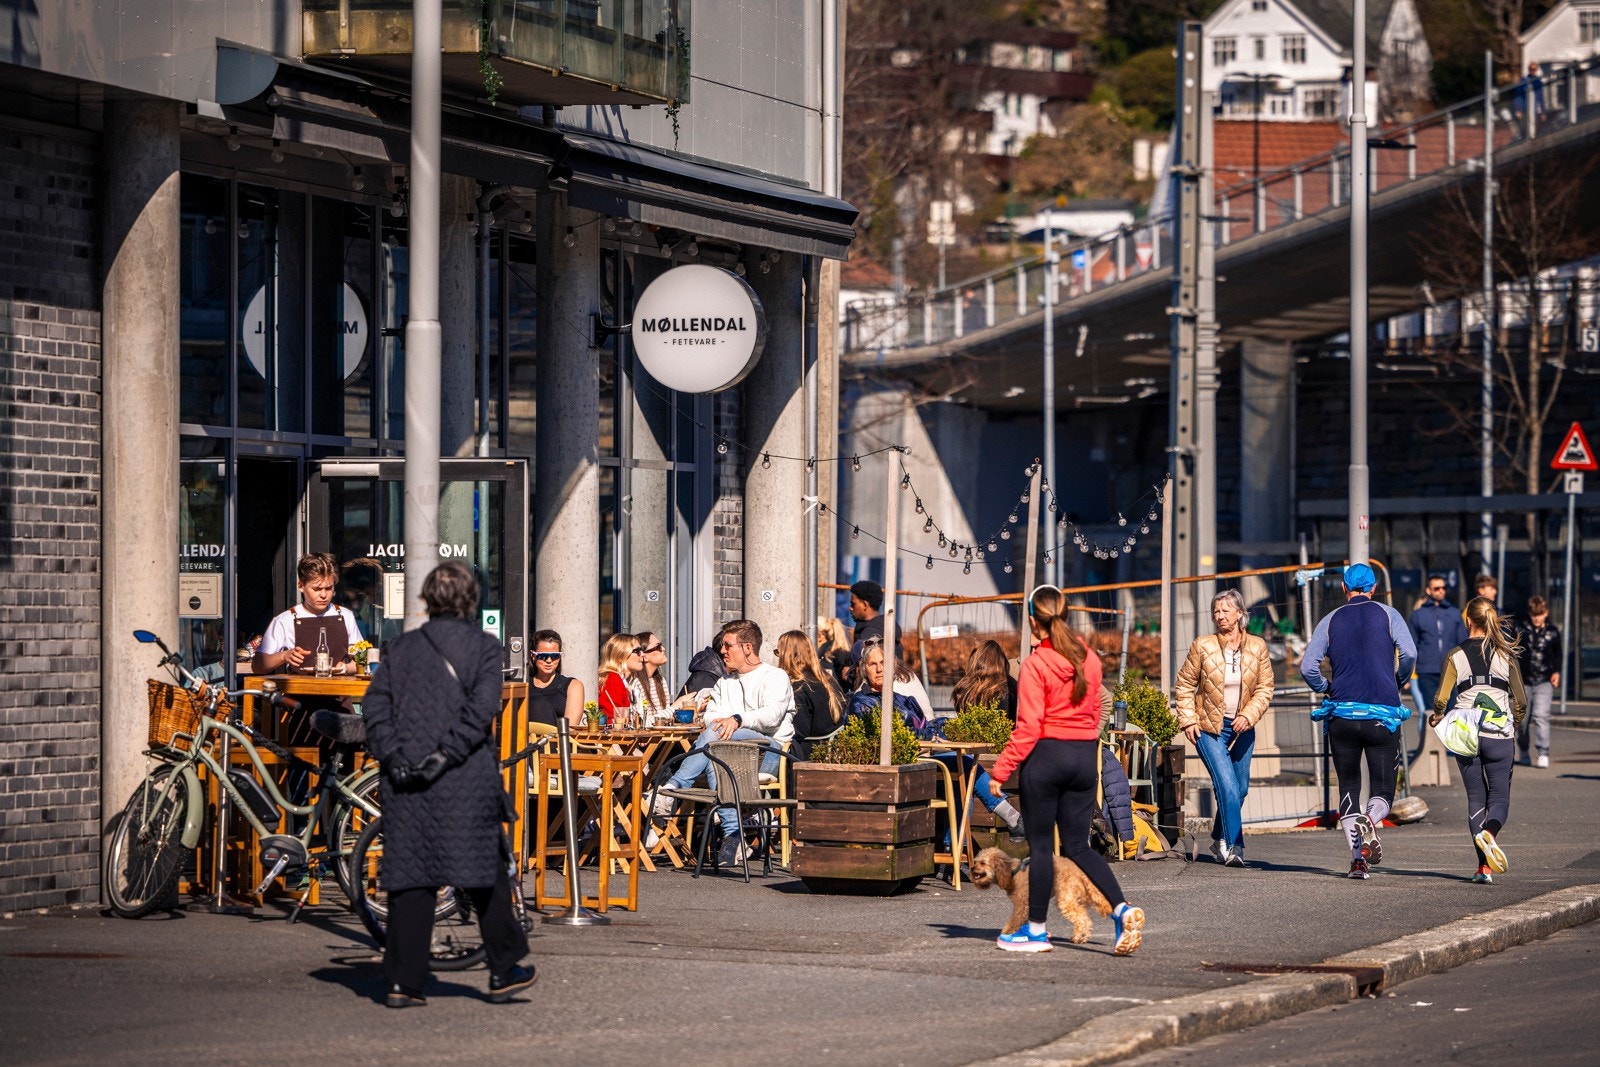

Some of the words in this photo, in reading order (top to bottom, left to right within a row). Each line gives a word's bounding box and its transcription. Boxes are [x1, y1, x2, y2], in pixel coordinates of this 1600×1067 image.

[642, 317, 746, 333] MØLLENDAL
[672, 338, 717, 346] FETEVARE
[180, 562, 213, 570] ETEVARE
